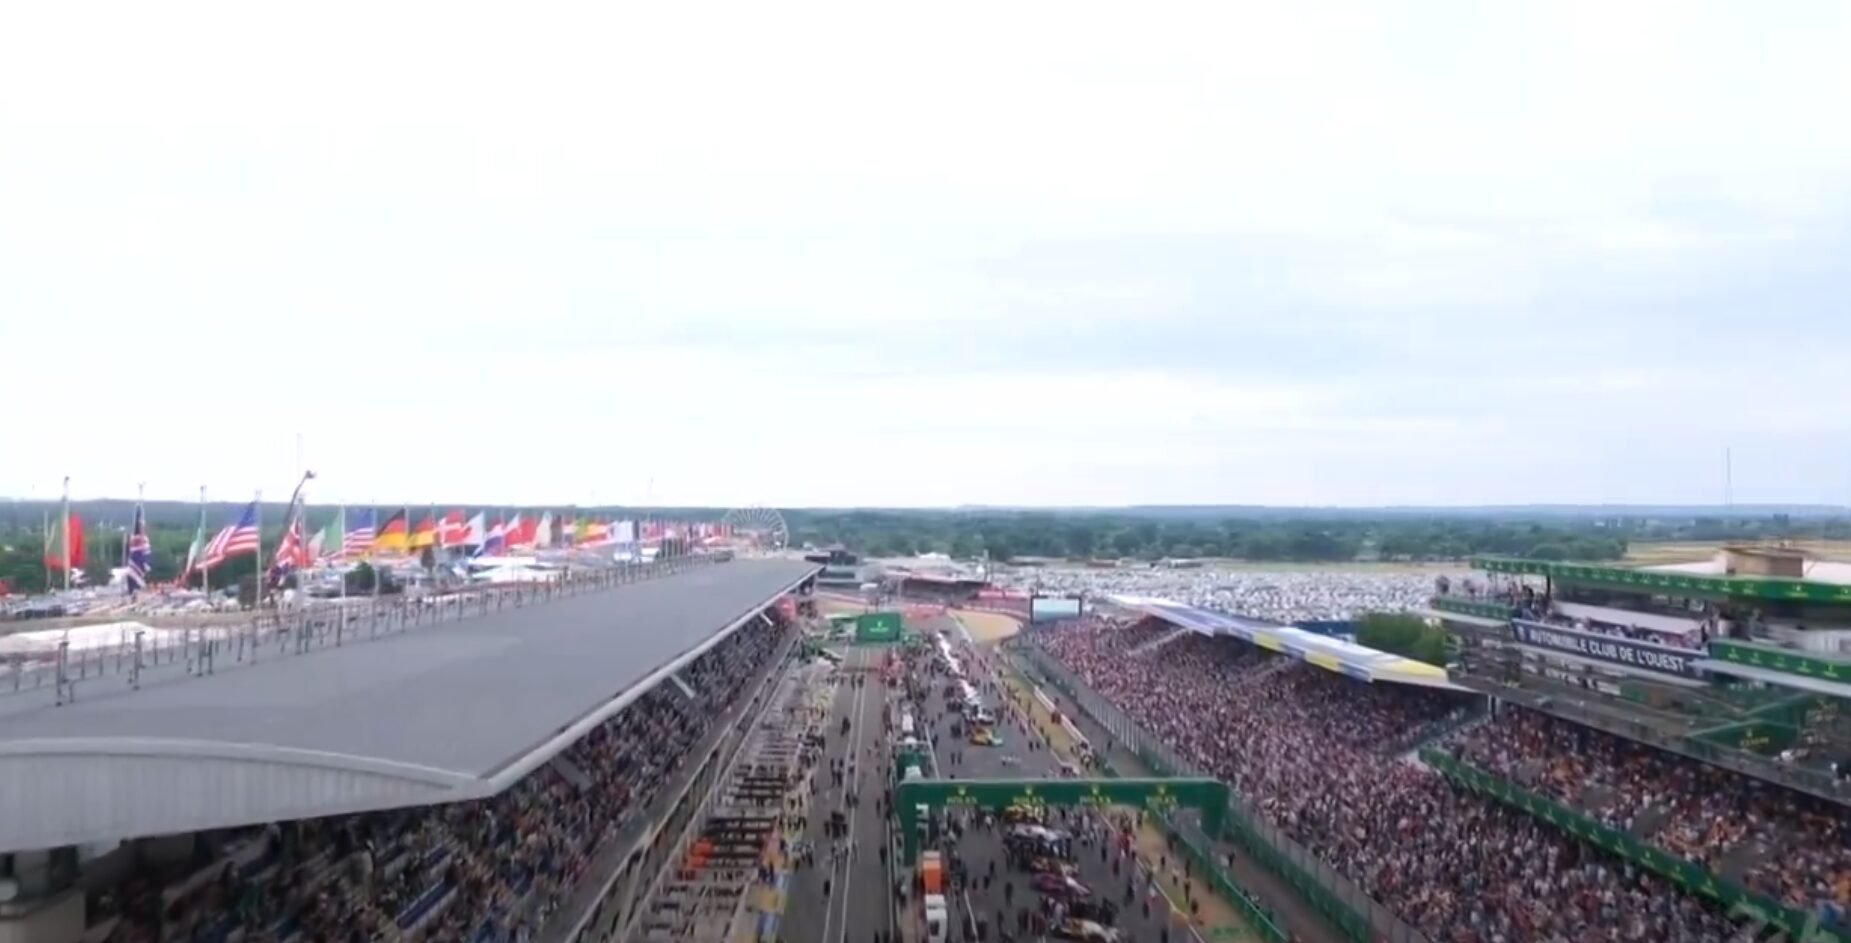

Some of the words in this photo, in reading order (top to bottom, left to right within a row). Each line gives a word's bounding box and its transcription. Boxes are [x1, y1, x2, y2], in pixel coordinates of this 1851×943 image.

[1589, 640, 1618, 659] CLUB
[1619, 645, 1635, 663] DE
[1636, 650, 1685, 673] L'OUEST
